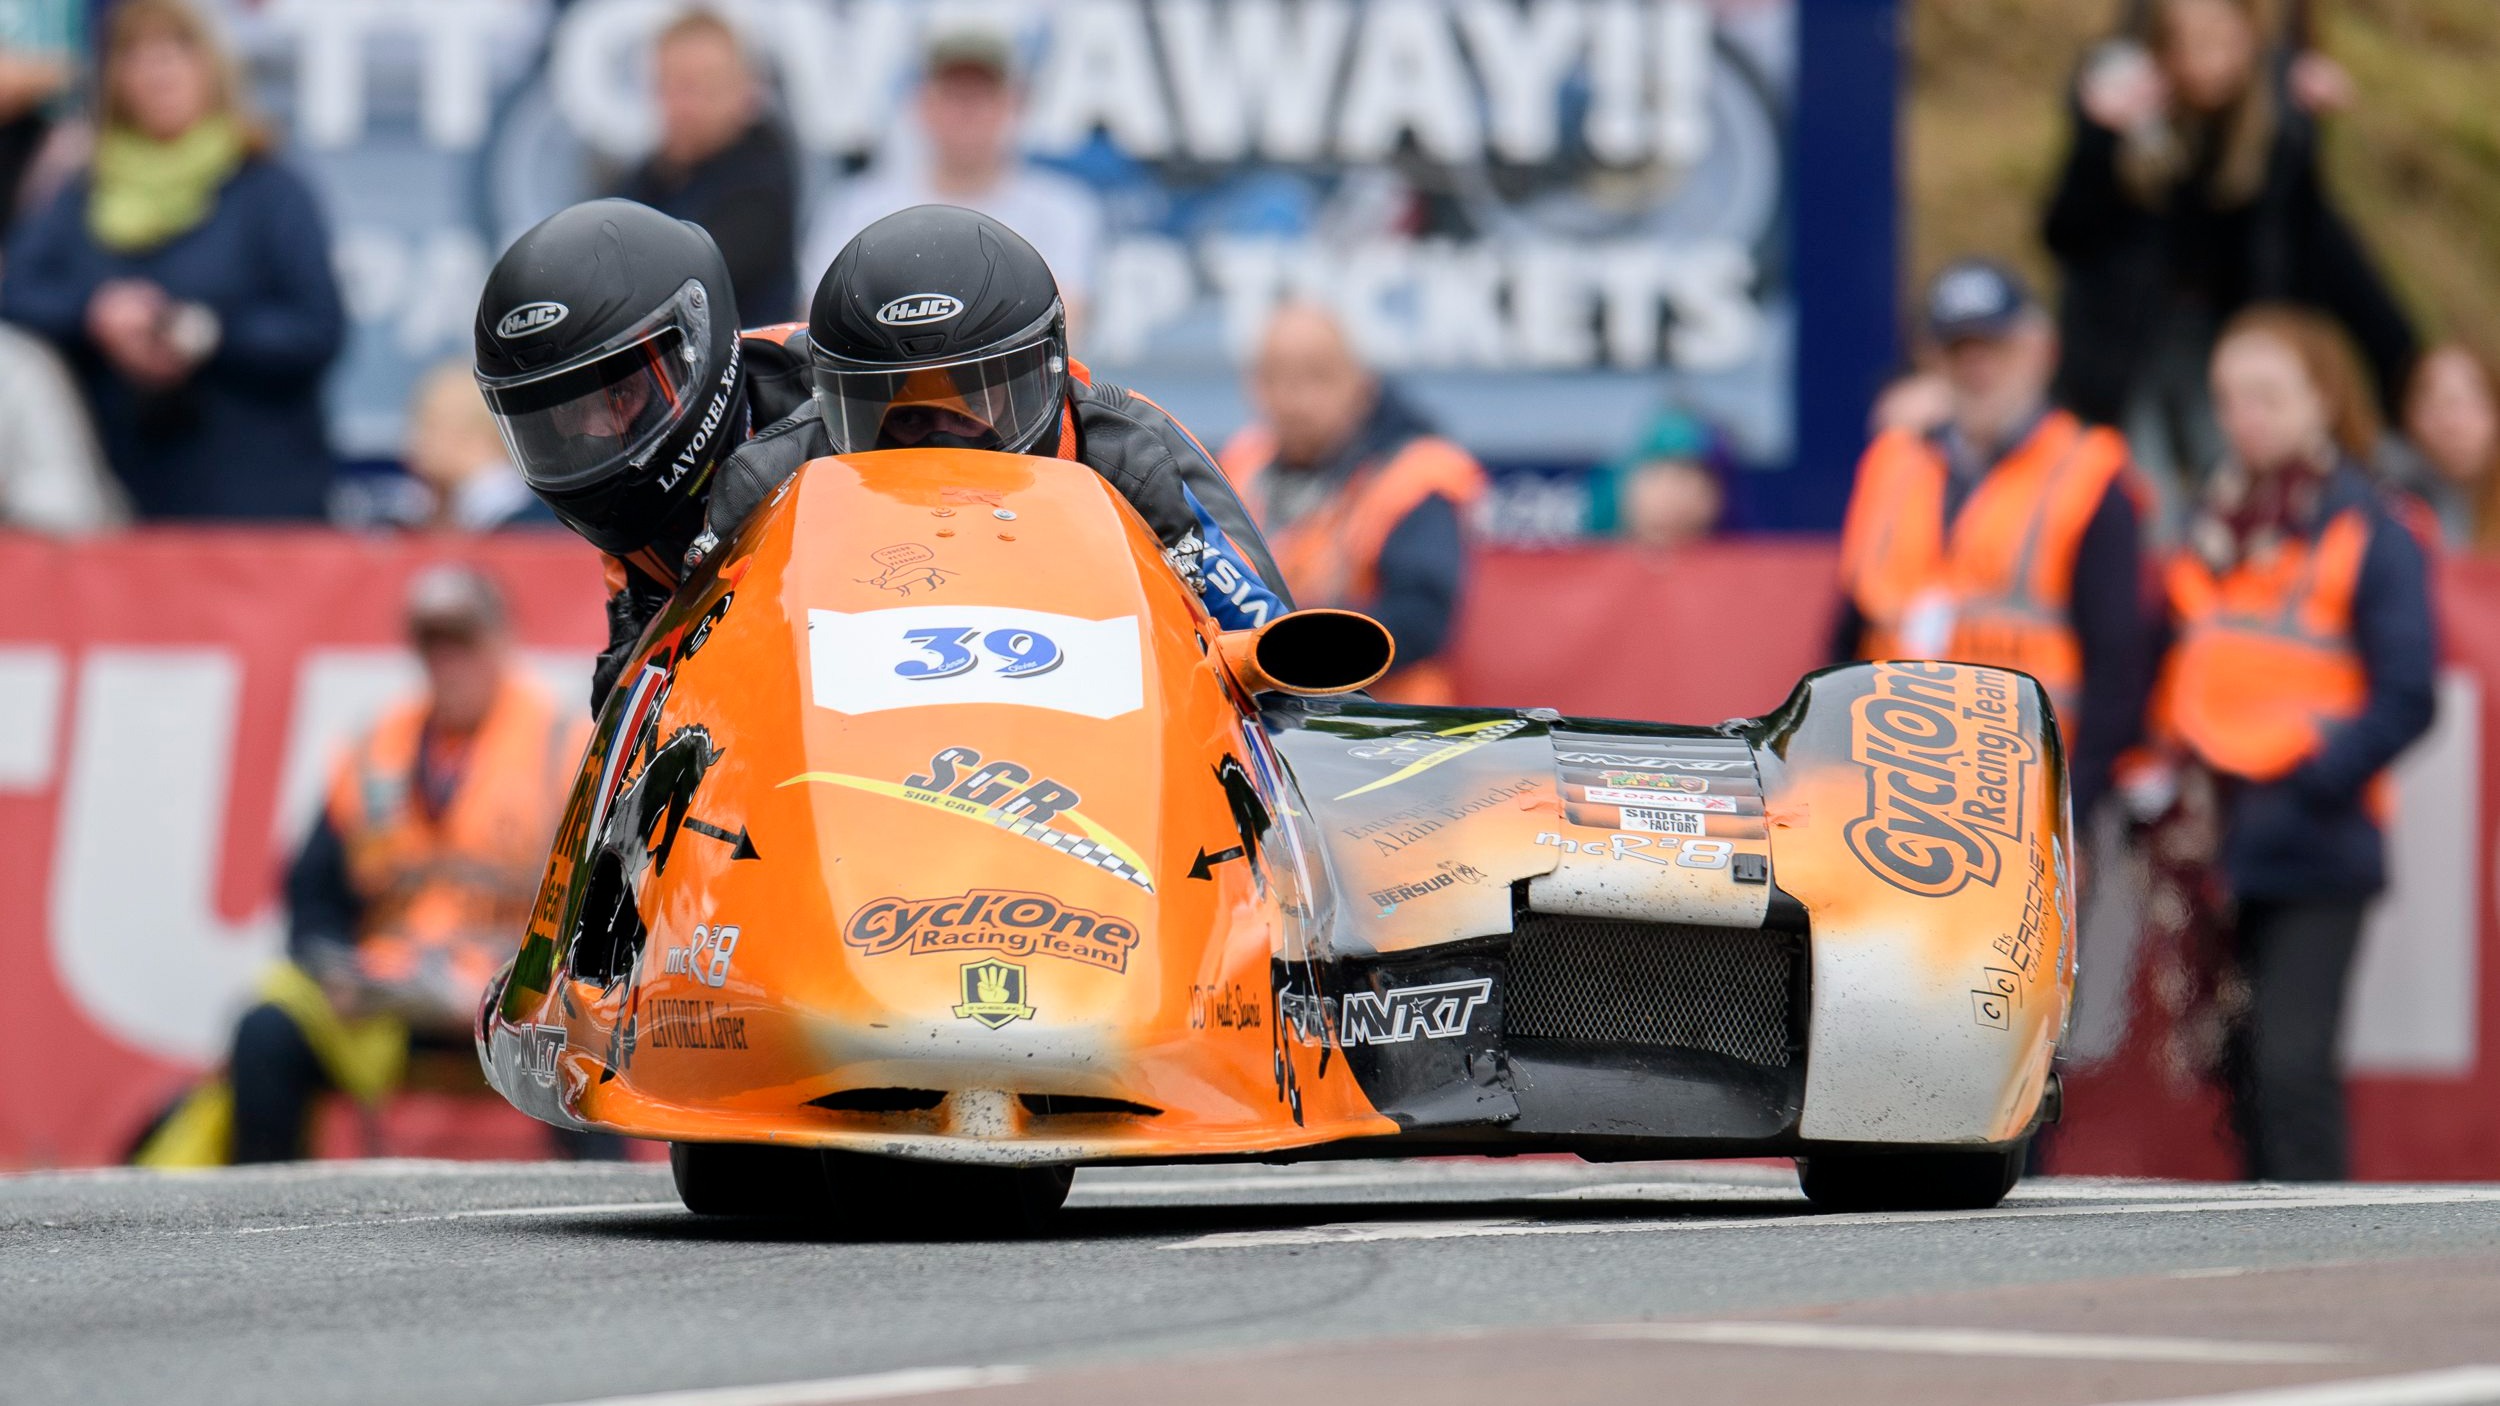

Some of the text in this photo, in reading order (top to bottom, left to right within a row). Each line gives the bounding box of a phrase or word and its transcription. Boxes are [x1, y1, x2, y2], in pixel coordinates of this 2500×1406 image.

[504, 304, 558, 334] HJC
[886, 298, 953, 322] HJC
[656, 392, 728, 494] LAVOREL
[720, 329, 741, 395] Xavier
[894, 626, 1064, 681] 39
[1962, 670, 2021, 825] Racing Team
[902, 746, 1081, 824] SGR
[1371, 777, 1543, 858] Alain Bouchet
[1625, 808, 1698, 823] SHOCK
[1649, 819, 1698, 834] FACTORY
[1370, 873, 1455, 907] BERSUB
[921, 926, 1119, 965] Racing Team
[649, 998, 749, 1050] LAVOREL Xavier
